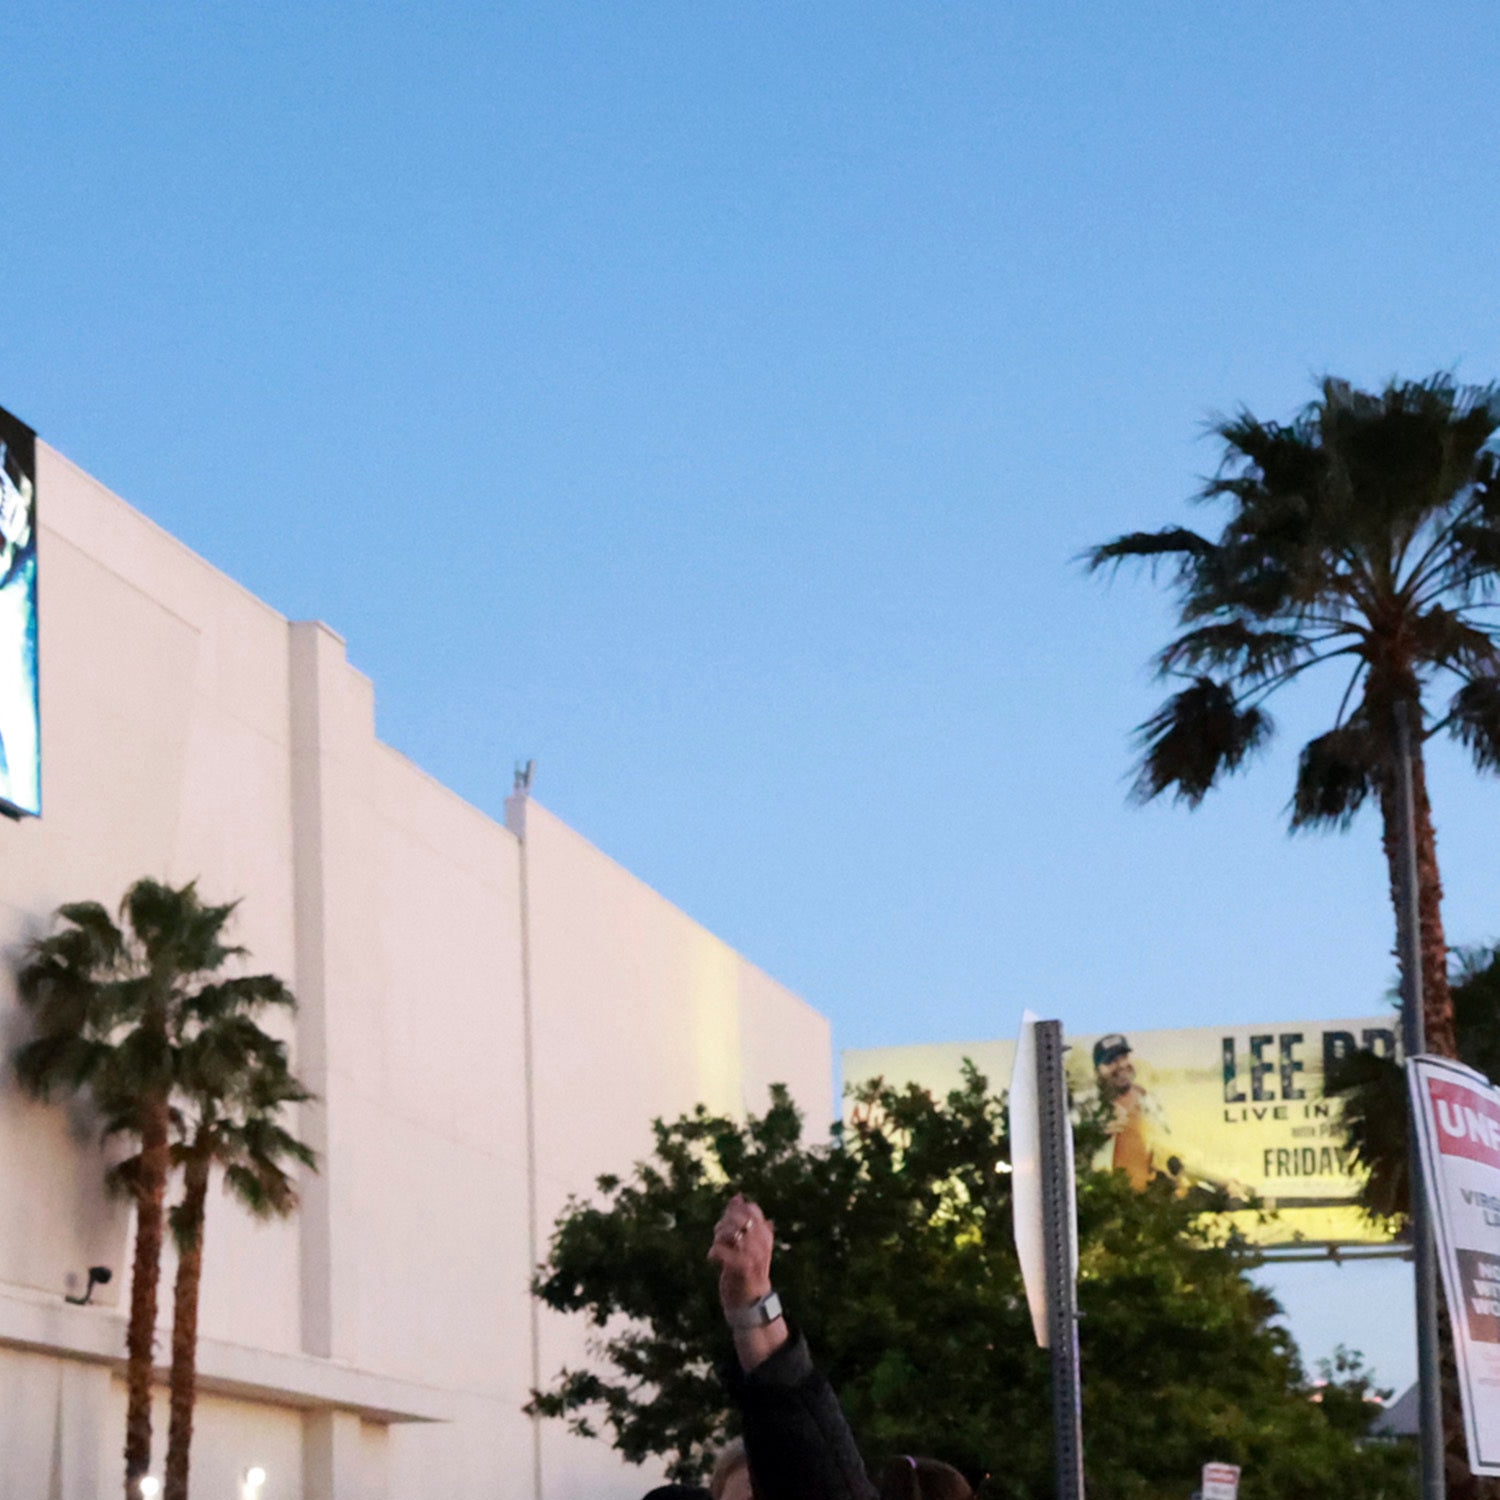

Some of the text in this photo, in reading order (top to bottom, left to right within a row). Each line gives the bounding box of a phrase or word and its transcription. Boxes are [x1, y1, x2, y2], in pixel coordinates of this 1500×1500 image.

[1222, 1032, 1306, 1103] LEE
[1224, 1104, 1330, 1123] LIVE IN
